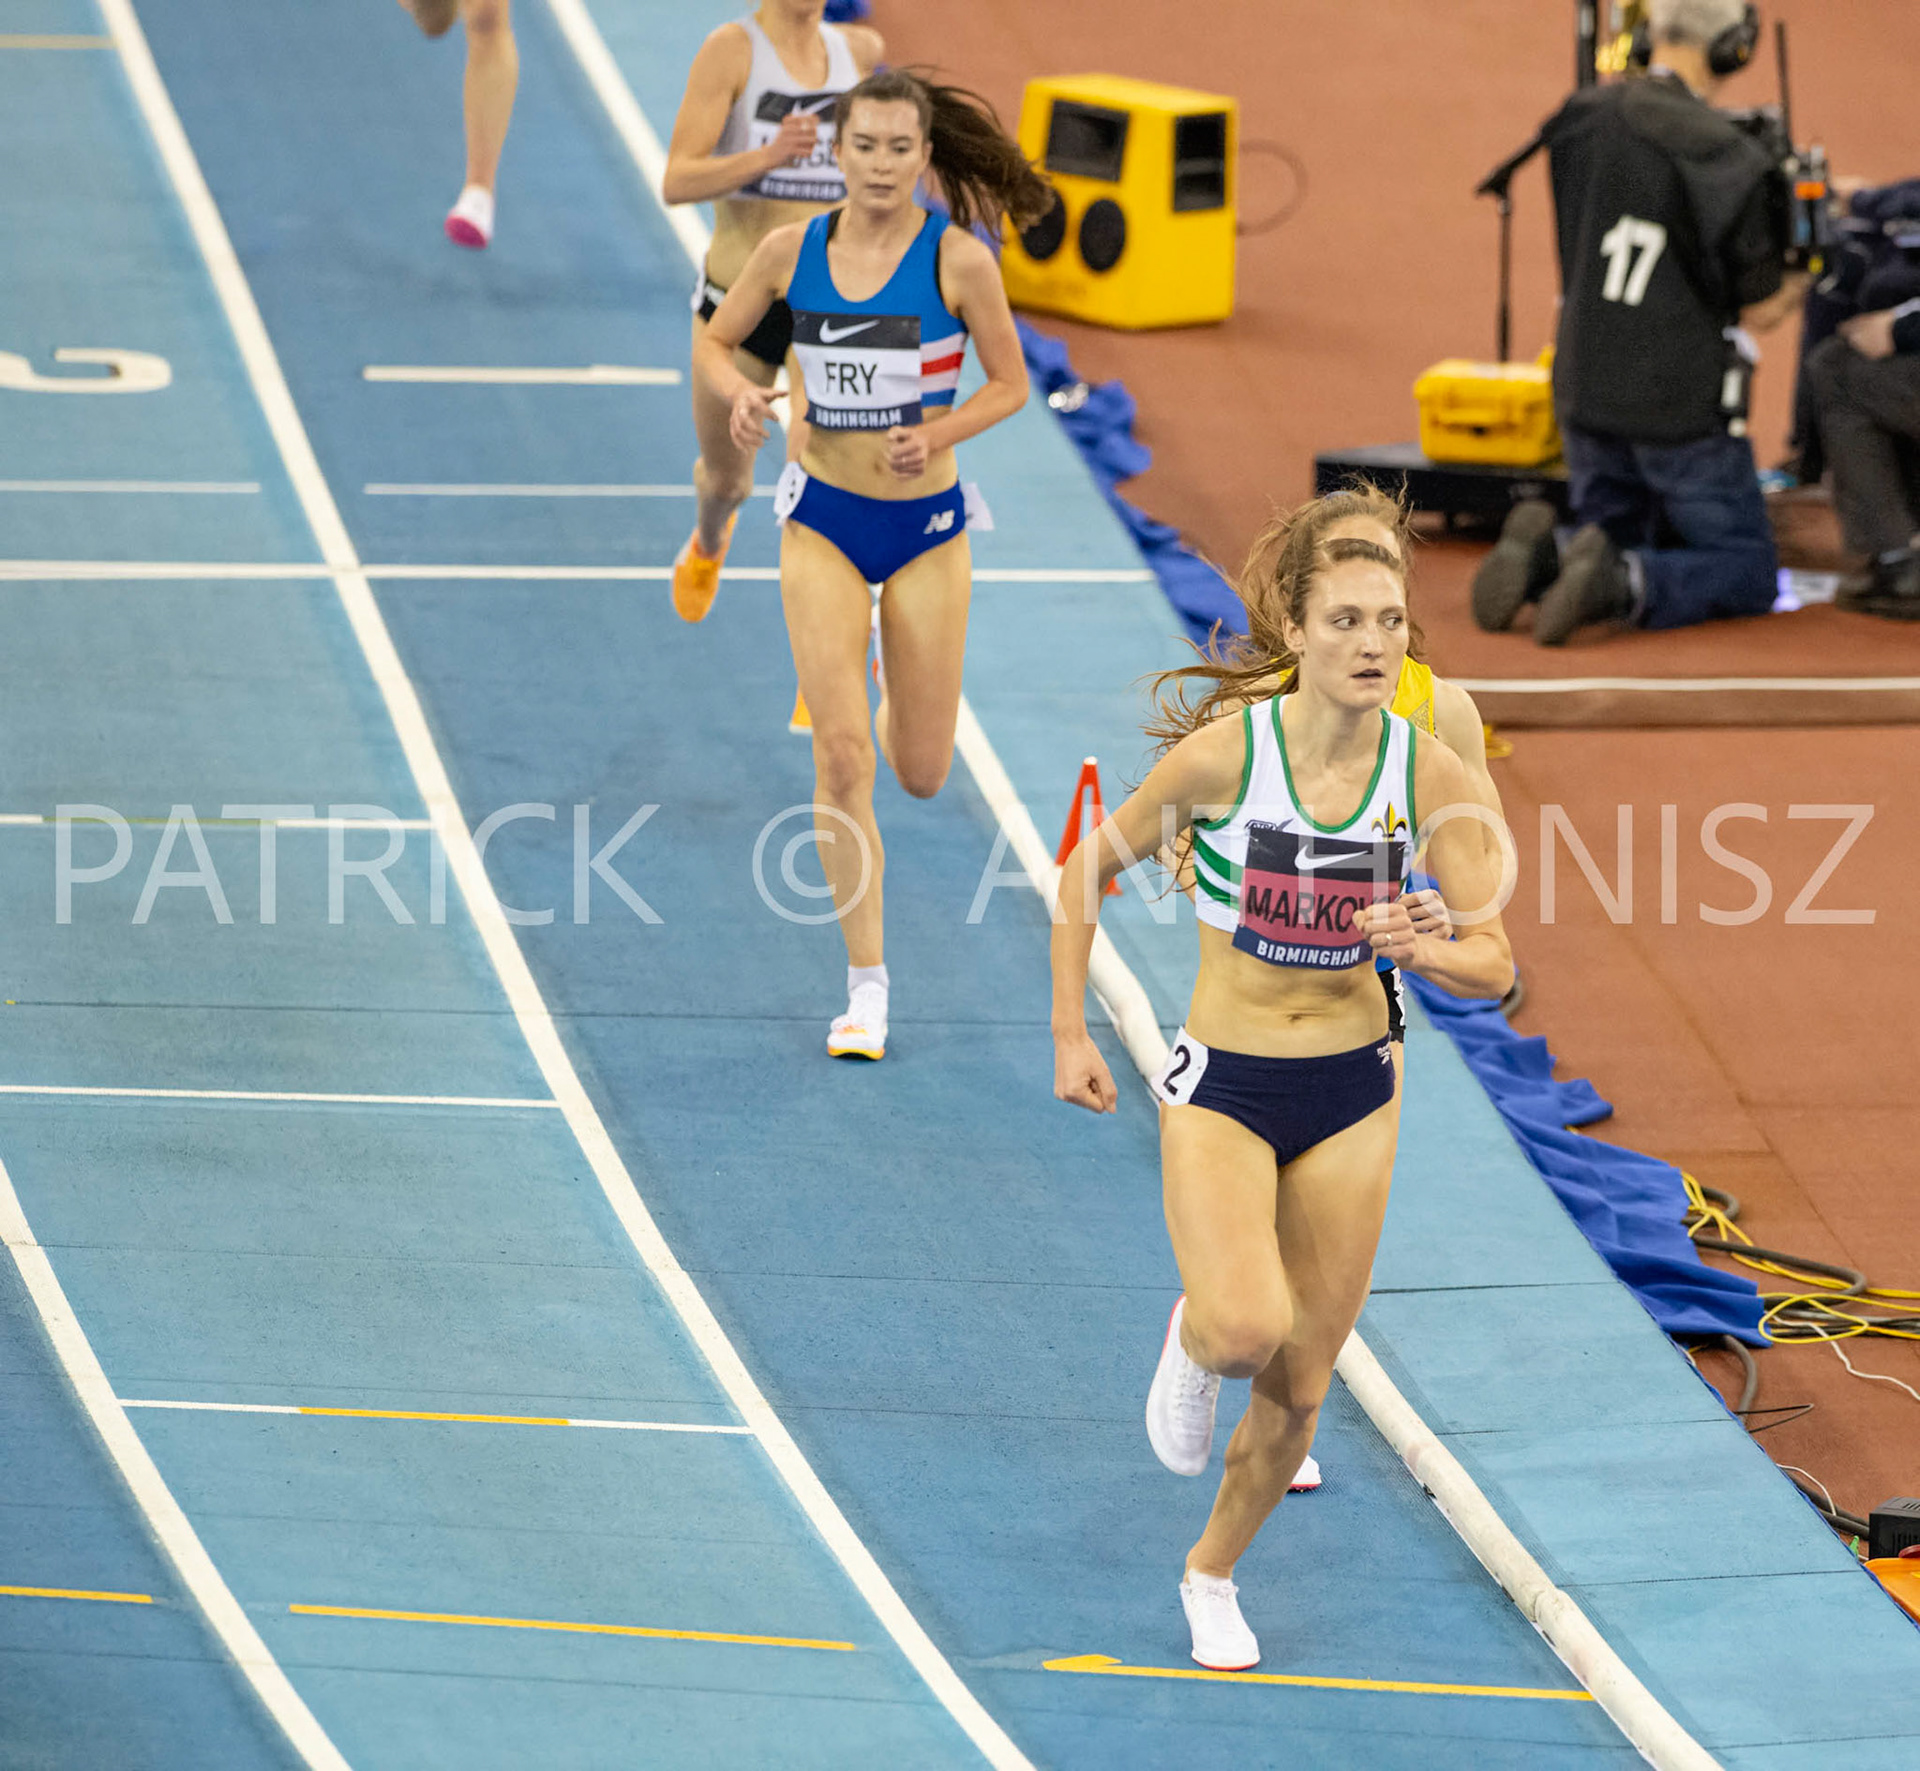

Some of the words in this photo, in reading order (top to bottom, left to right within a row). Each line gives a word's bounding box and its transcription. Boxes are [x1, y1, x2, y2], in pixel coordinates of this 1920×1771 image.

[1601, 214, 1667, 306] 17
[824, 361, 877, 395] FRY
[1246, 885, 1391, 933] MARKO
[1256, 939, 1361, 966] BIRMINGHAM
[1163, 1044, 1191, 1096] 2
